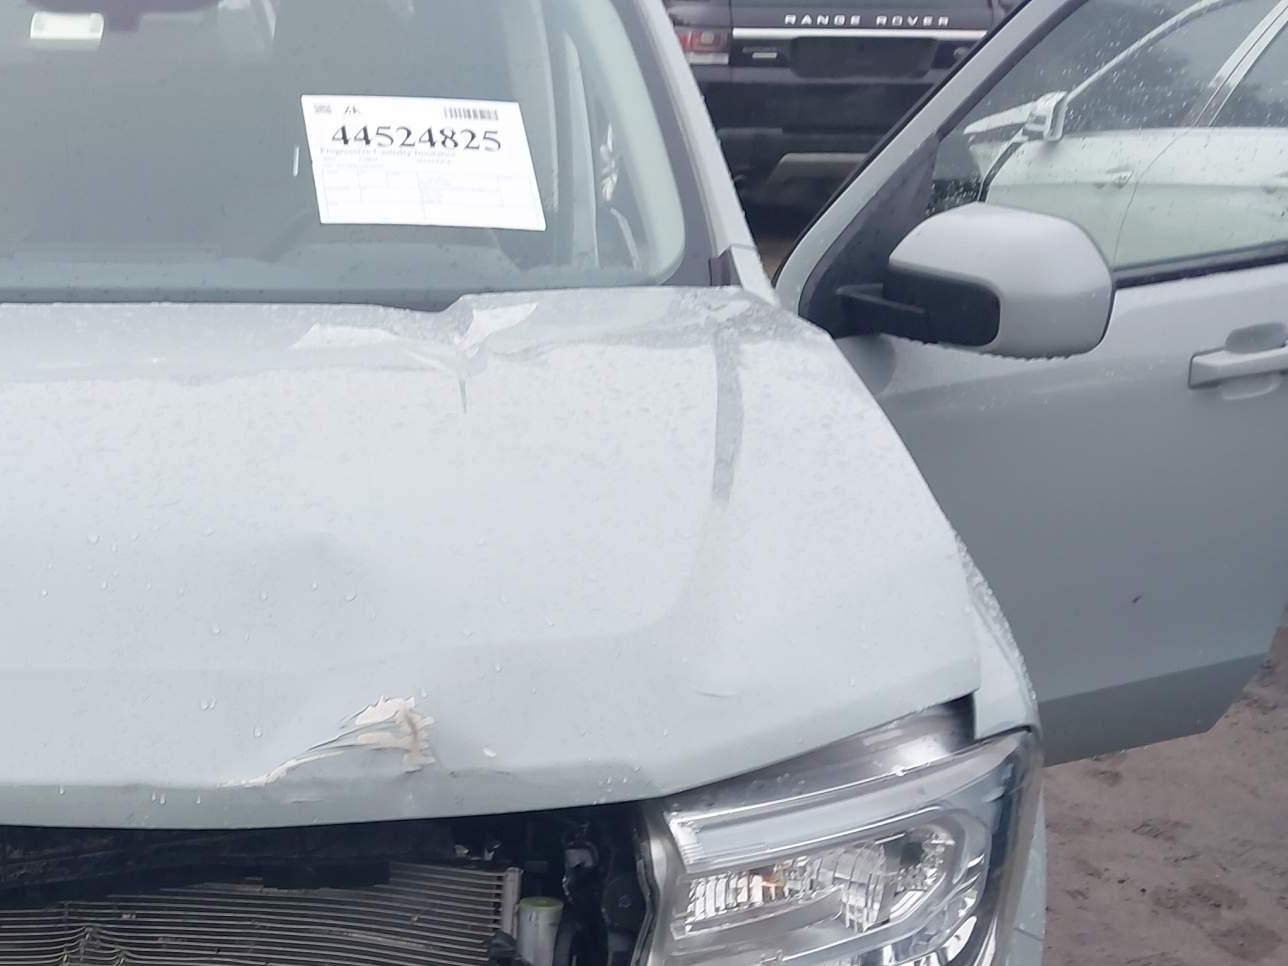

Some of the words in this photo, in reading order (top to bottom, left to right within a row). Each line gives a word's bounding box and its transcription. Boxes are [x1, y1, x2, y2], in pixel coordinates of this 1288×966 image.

[784, 14, 861, 26] RANGE
[875, 15, 949, 27] ROVER
[331, 125, 501, 153] 44524825
